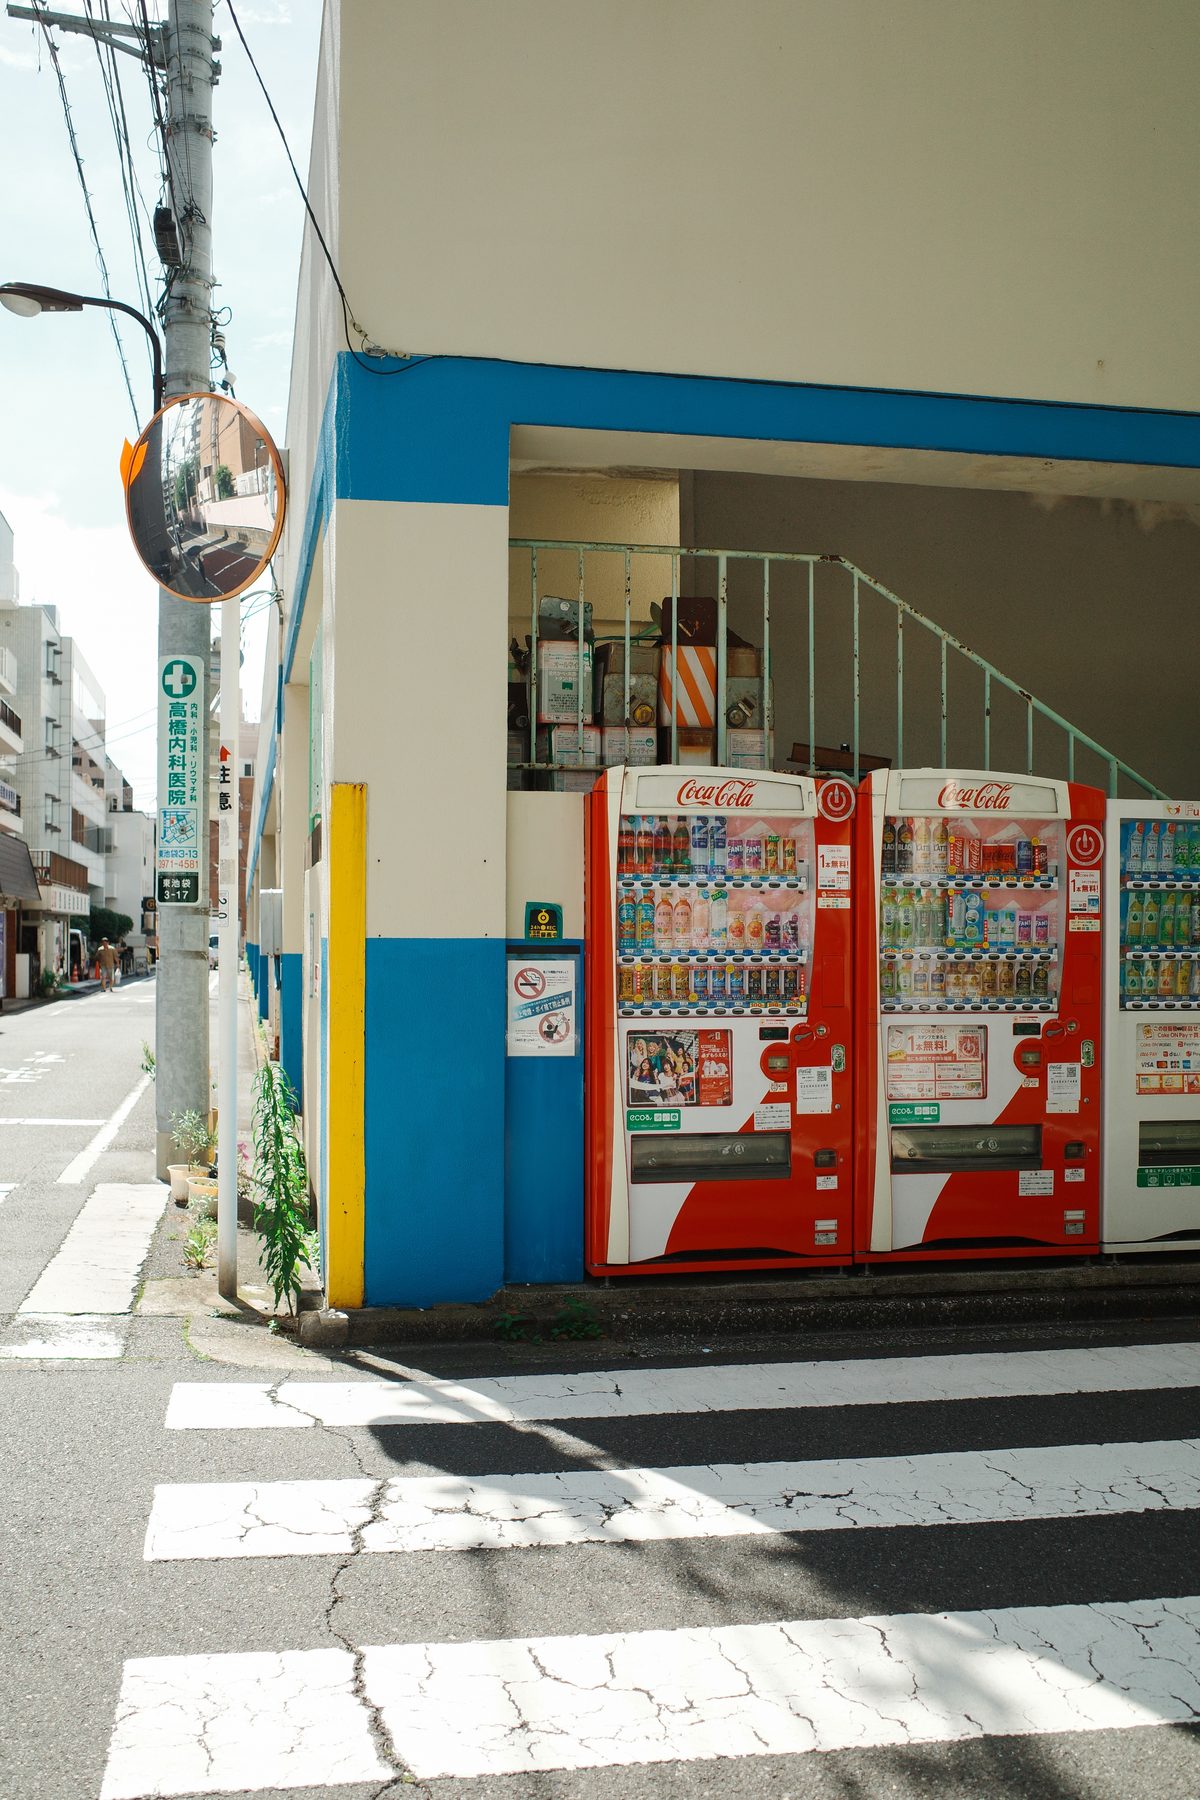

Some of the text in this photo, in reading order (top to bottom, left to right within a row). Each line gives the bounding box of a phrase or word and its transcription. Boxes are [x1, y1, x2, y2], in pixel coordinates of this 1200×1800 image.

[168, 702, 188, 806] 高橋内科医院
[190, 703, 198, 803] 内科・小児科・リウマチ科
[676, 779, 757, 808] Coca-Cola
[937, 782, 1014, 810] Coca-Cola
[820, 854, 849, 868] 1本無料!
[163, 879, 191, 888] 東池袋
[1070, 879, 1099, 893] 1本無料!
[164, 891, 189, 900] 3-17
[907, 1034, 948, 1052] 1本無料!
